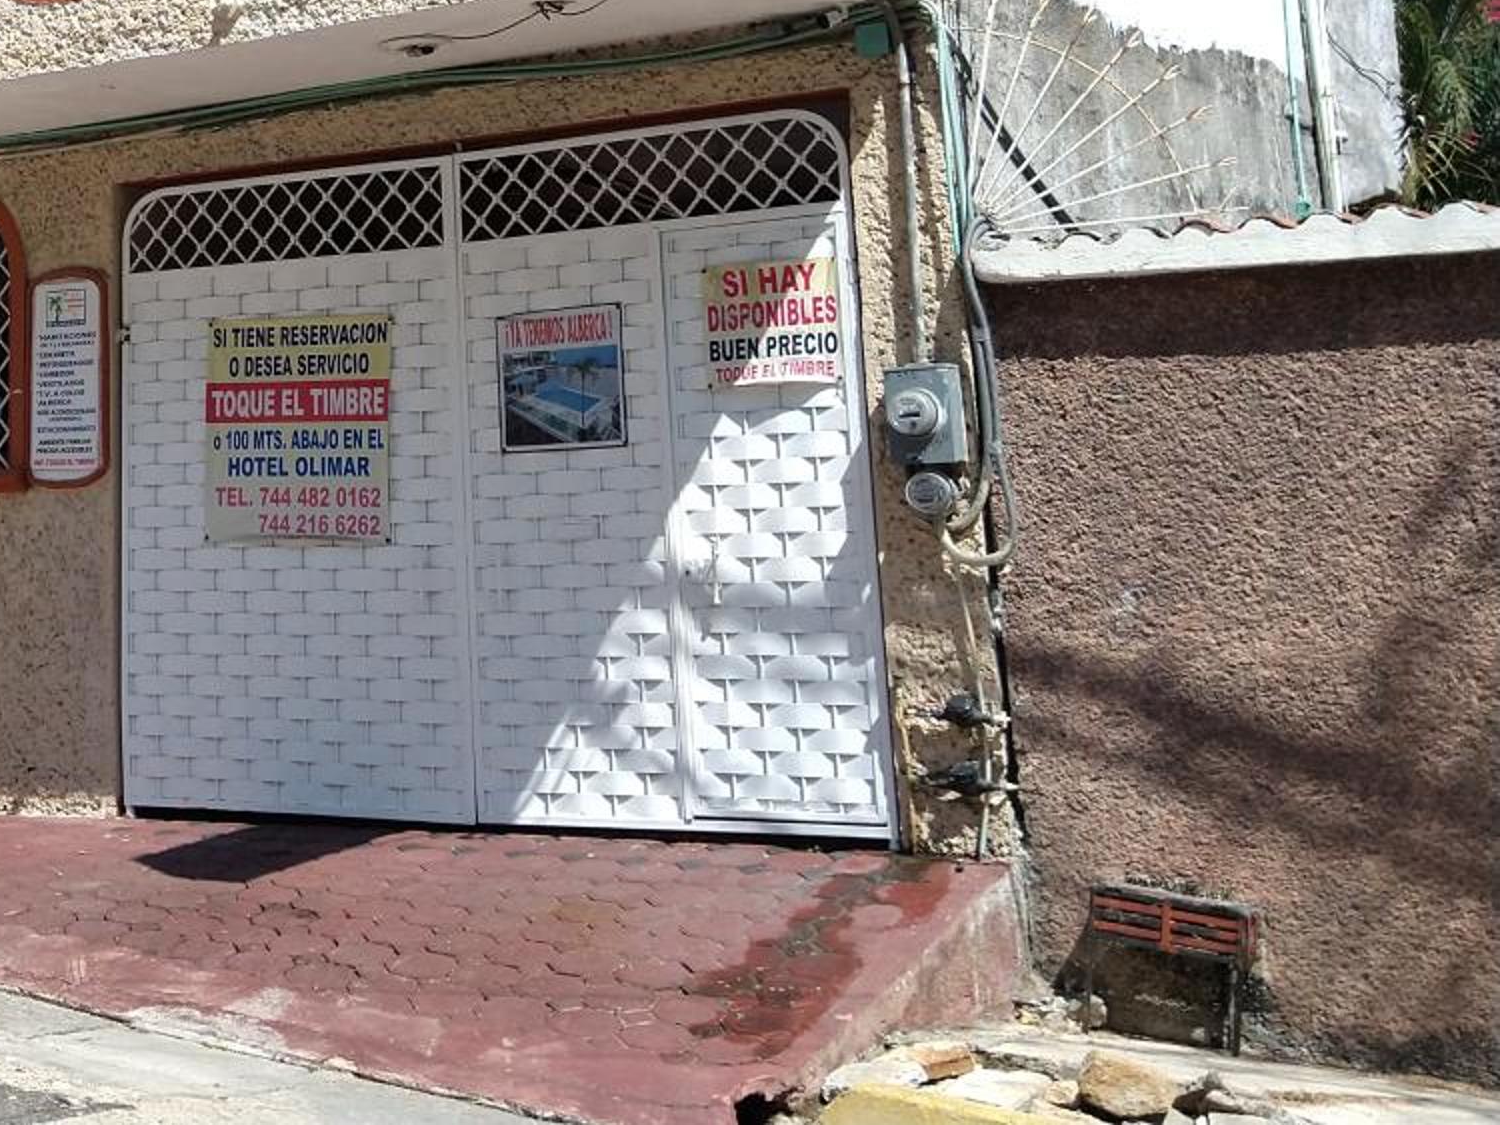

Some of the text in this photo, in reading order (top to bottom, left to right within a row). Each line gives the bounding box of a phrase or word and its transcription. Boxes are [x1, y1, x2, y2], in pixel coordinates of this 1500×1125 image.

[722, 262, 816, 297] SI HAY
[707, 296, 837, 332] DISPONIBLES
[213, 322, 388, 348] SI TIENE RESERVACION
[709, 332, 838, 362] BUEN PRECIO
[229, 352, 370, 377] O DESEA SERVICIO
[211, 386, 385, 418] TOQUE EL TIMBRE
[226, 429, 249, 450] 100
[253, 430, 287, 450] MTS.
[291, 429, 339, 450] ABAJO
[343, 430, 363, 449] EN
[368, 428, 384, 449] EL
[228, 457, 370, 477] HOTEL OLIMAR
[215, 487, 381, 507] TEL. 744 482 0162
[259, 514, 381, 535] 744 216 6262
